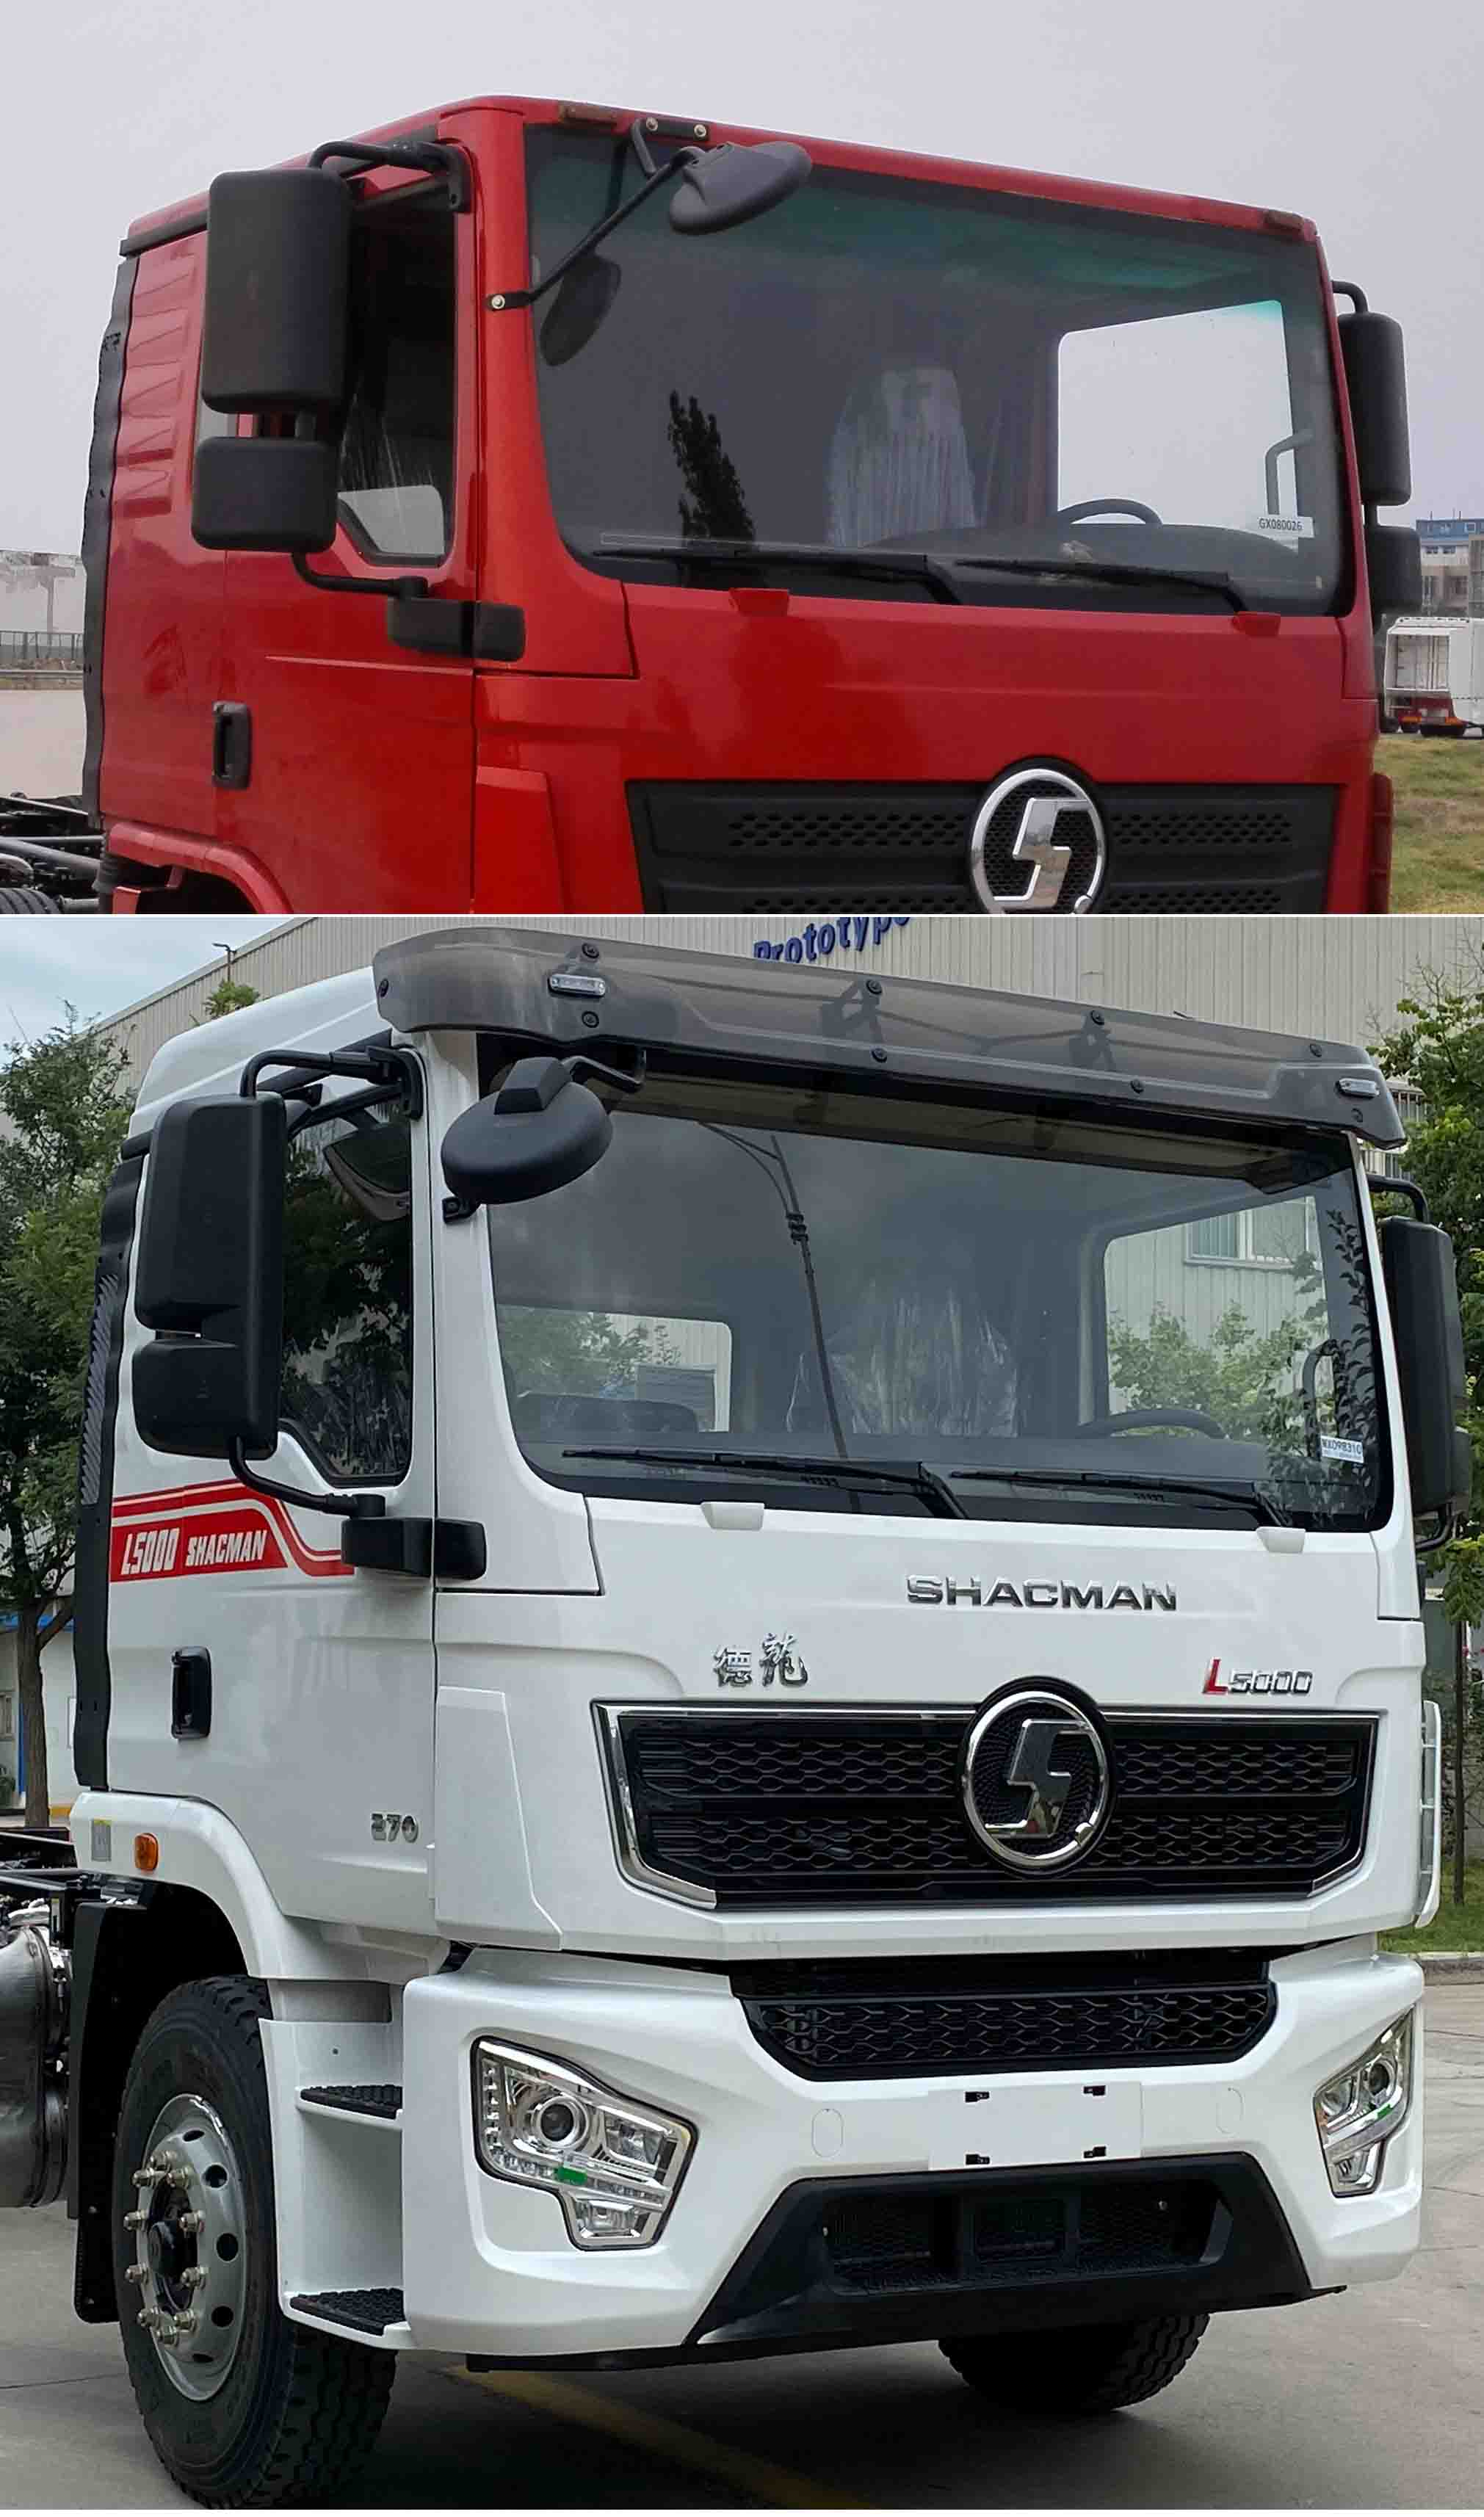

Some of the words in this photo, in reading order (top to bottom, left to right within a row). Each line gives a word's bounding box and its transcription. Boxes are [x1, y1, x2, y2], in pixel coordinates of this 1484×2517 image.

[1259, 518, 1303, 531] GX080026
[121, 1528, 180, 1575] L5000
[185, 1530, 267, 1566] SHACMAN
[906, 1574, 1176, 1611] SHACMAN
[1202, 1657, 1313, 1695] L5000
[370, 1811, 419, 1844] 270
